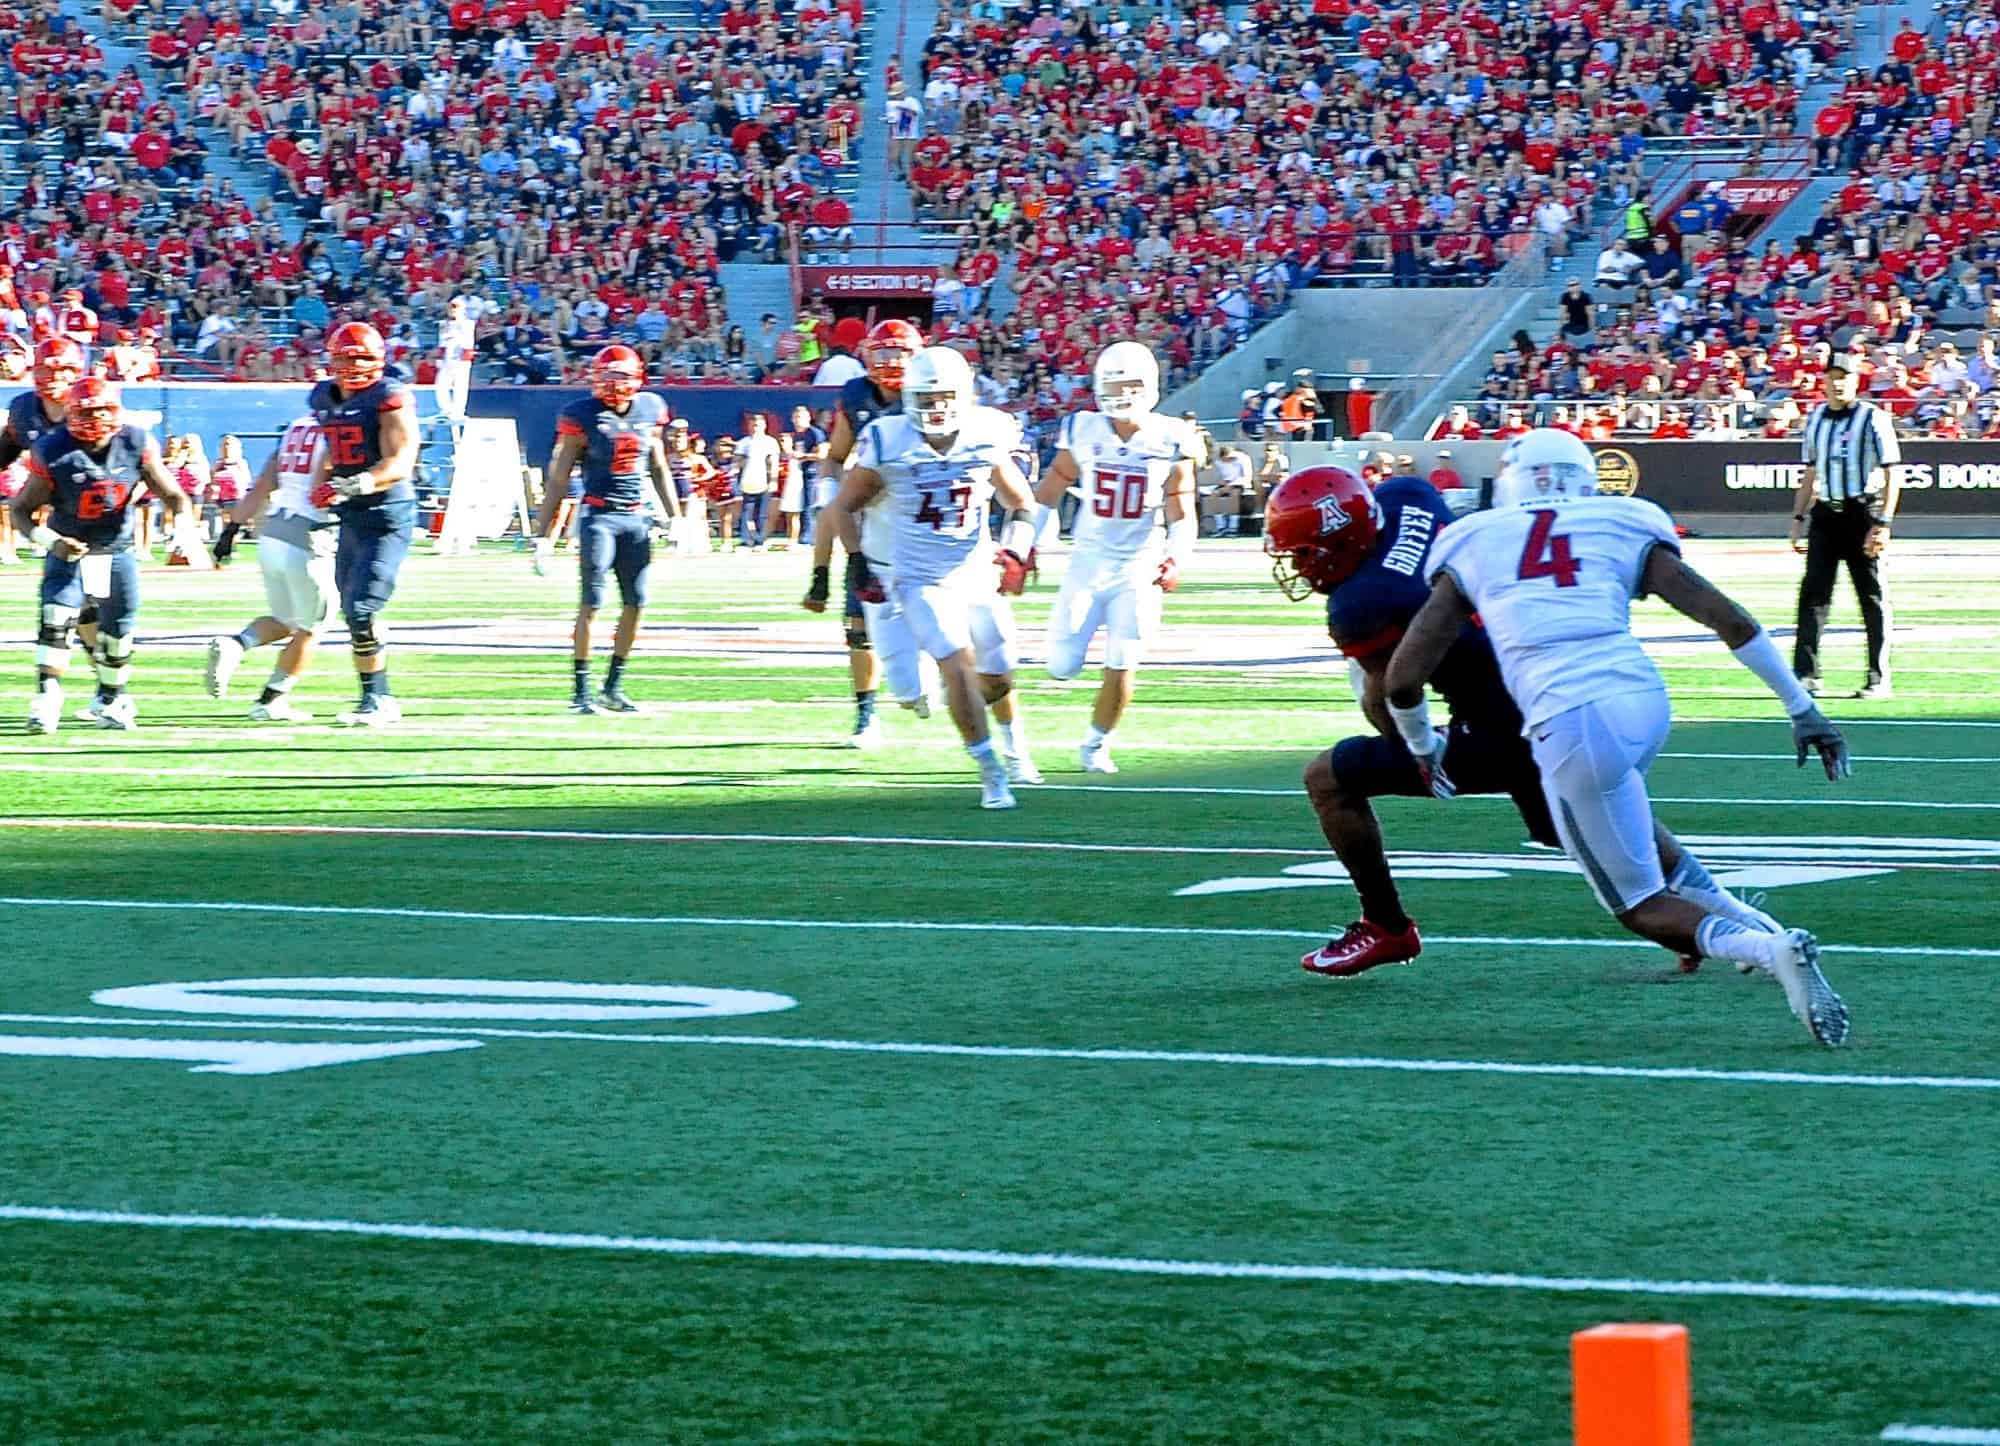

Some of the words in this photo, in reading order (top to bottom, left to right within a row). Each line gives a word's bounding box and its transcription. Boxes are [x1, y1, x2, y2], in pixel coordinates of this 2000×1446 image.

[851, 275, 904, 290] SECTION
[1094, 470, 1147, 519] 50
[1725, 463, 1806, 490] UNITE
[1382, 505, 1435, 576] GRIFFEY
[1517, 509, 1582, 588] 4
